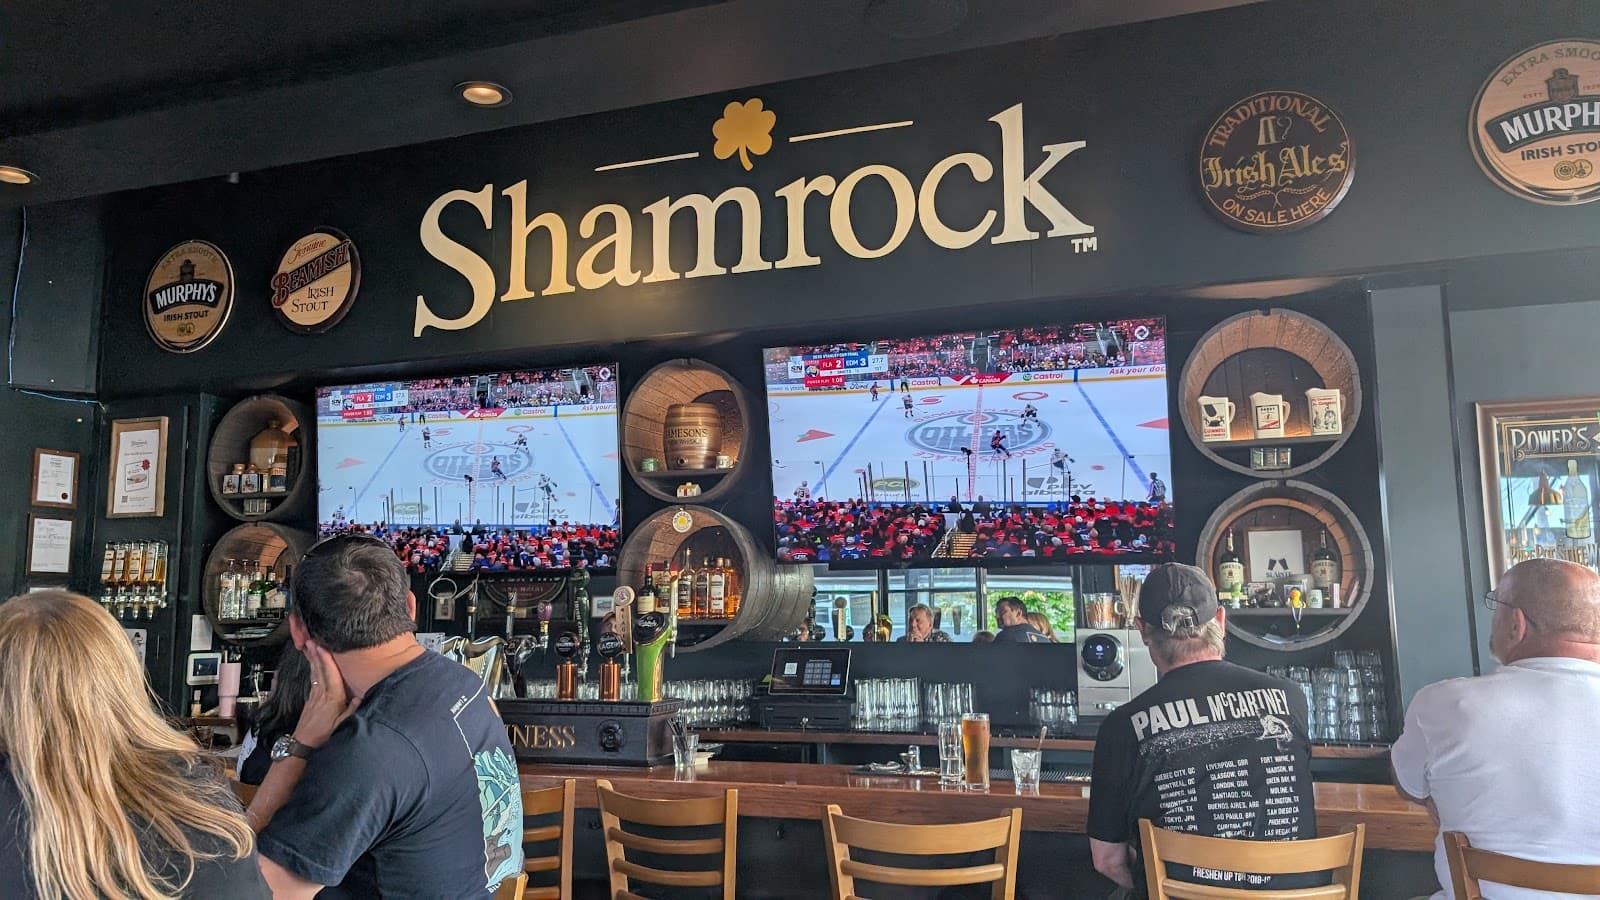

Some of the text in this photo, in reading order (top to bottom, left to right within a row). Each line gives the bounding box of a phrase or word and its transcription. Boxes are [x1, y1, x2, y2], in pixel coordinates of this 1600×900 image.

[1502, 52, 1550, 87] EXTRA
[1209, 95, 1332, 147] TRADITIONAL
[1521, 146, 1562, 161] IRISH
[1203, 141, 1348, 192] Irish Ales
[1223, 188, 1331, 224] ON SALE HERE
[414, 103, 1098, 337] Shamrock TM
[271, 241, 351, 308] BEAMISH
[307, 286, 334, 299] IRISH
[291, 299, 328, 313] STOUT
[163, 310, 209, 321] IRISH STOUT
[835, 360, 842, 368] 2
[859, 358, 866, 366] 3
[1033, 372, 1064, 381] Castrol
[1109, 367, 1126, 375] Ask
[1127, 366, 1147, 376] your
[911, 378, 939, 386] Castrol
[367, 394, 372, 402] 2
[386, 392, 392, 400] 3
[919, 422, 1036, 451] OILERS
[1510, 426, 1591, 461] POWER'S
[1130, 698, 1210, 742] PAUL
[504, 723, 577, 750] NESS
[1260, 755, 1273, 764] FORT
[1205, 760, 1238, 771] LIVERPOOL,
[1174, 769, 1187, 778] CITY,
[1210, 771, 1237, 781] GLASGOW,
[1213, 781, 1236, 790] LONDON,
[1212, 791, 1241, 800] SANTIAGO,
[1265, 796, 1293, 805] ARLINGTON,
[1207, 802, 1229, 810] BUENOS
[1266, 808, 1277, 816] SAN
[1293, 805, 1300, 813] CA
[1264, 829, 1274, 837] LAS
[1192, 866, 1223, 881] FRESHEN
[1223, 871, 1233, 881] UP
